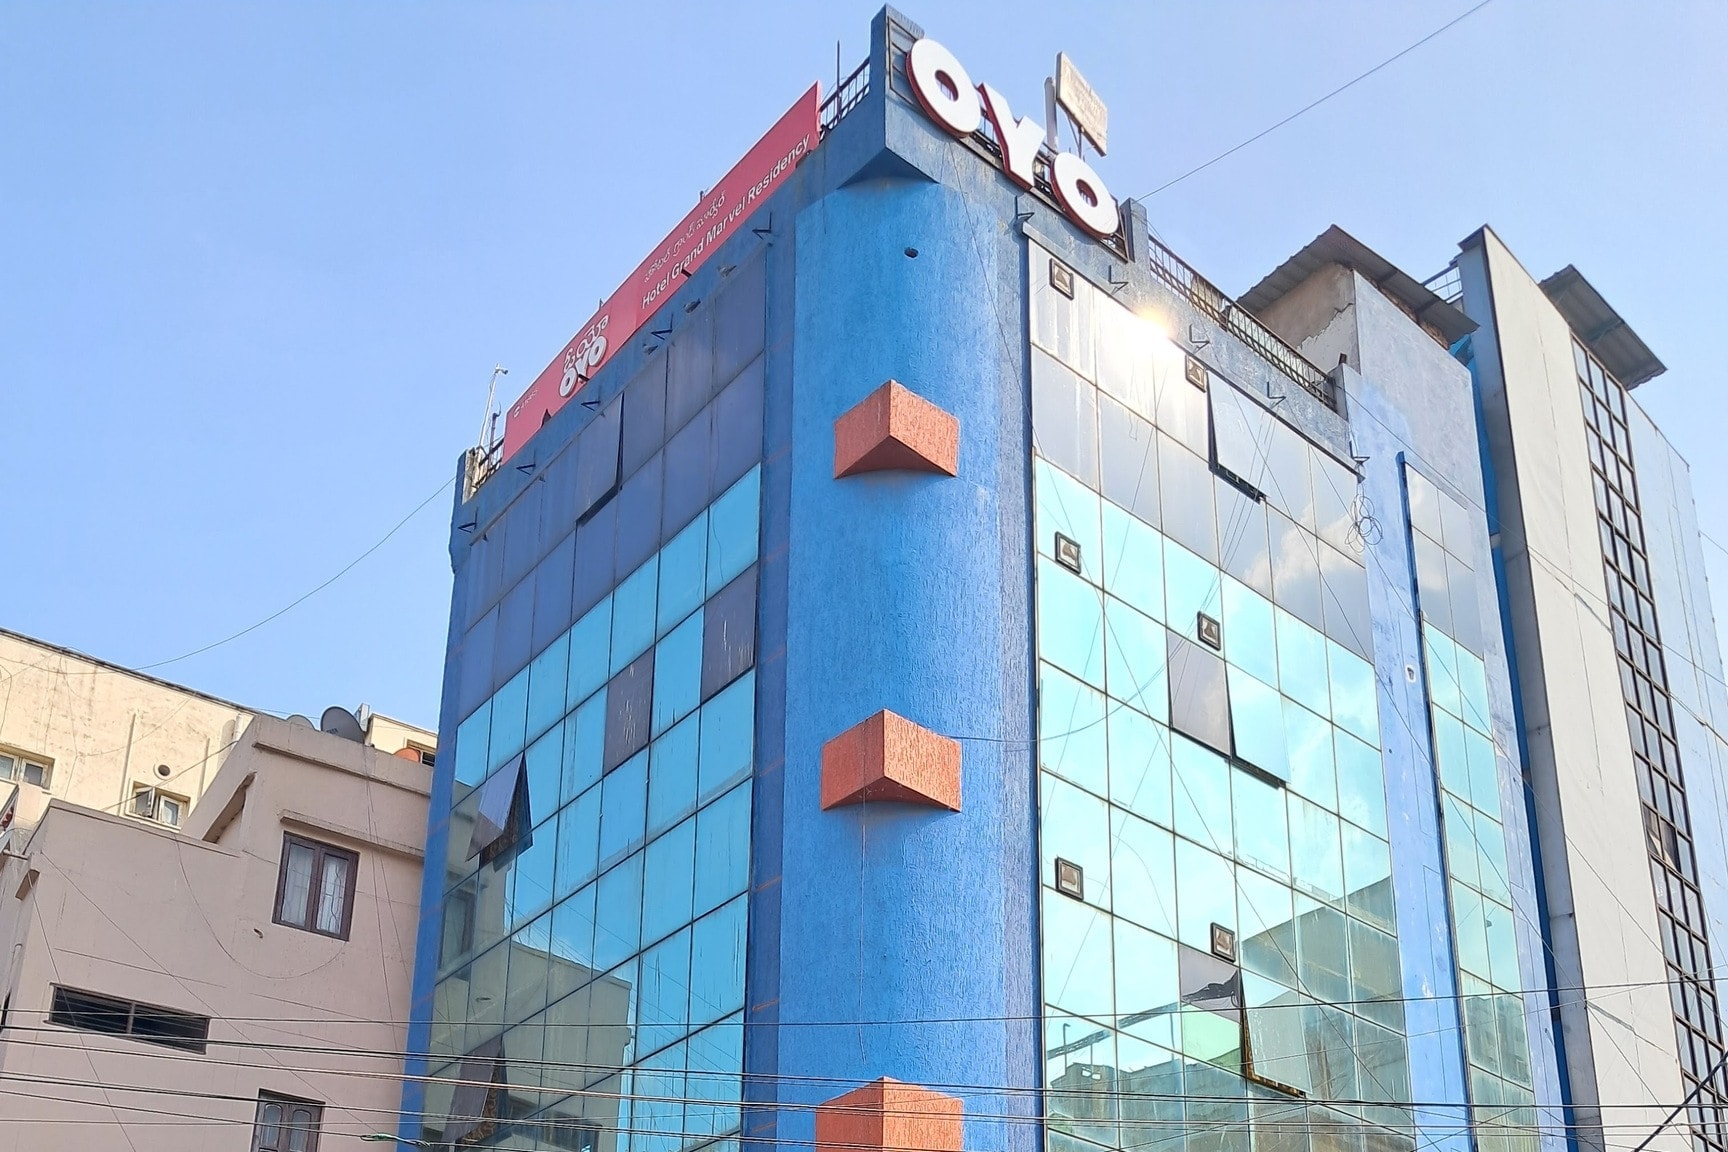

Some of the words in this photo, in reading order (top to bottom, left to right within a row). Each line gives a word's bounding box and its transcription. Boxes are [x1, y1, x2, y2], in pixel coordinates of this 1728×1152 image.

[641, 272, 670, 309] Hotel
[671, 237, 704, 279] Grand
[706, 196, 746, 246] Marvel
[747, 134, 810, 204] Residency
[906, 38, 1119, 238] OYO
[559, 335, 607, 397] OYO
